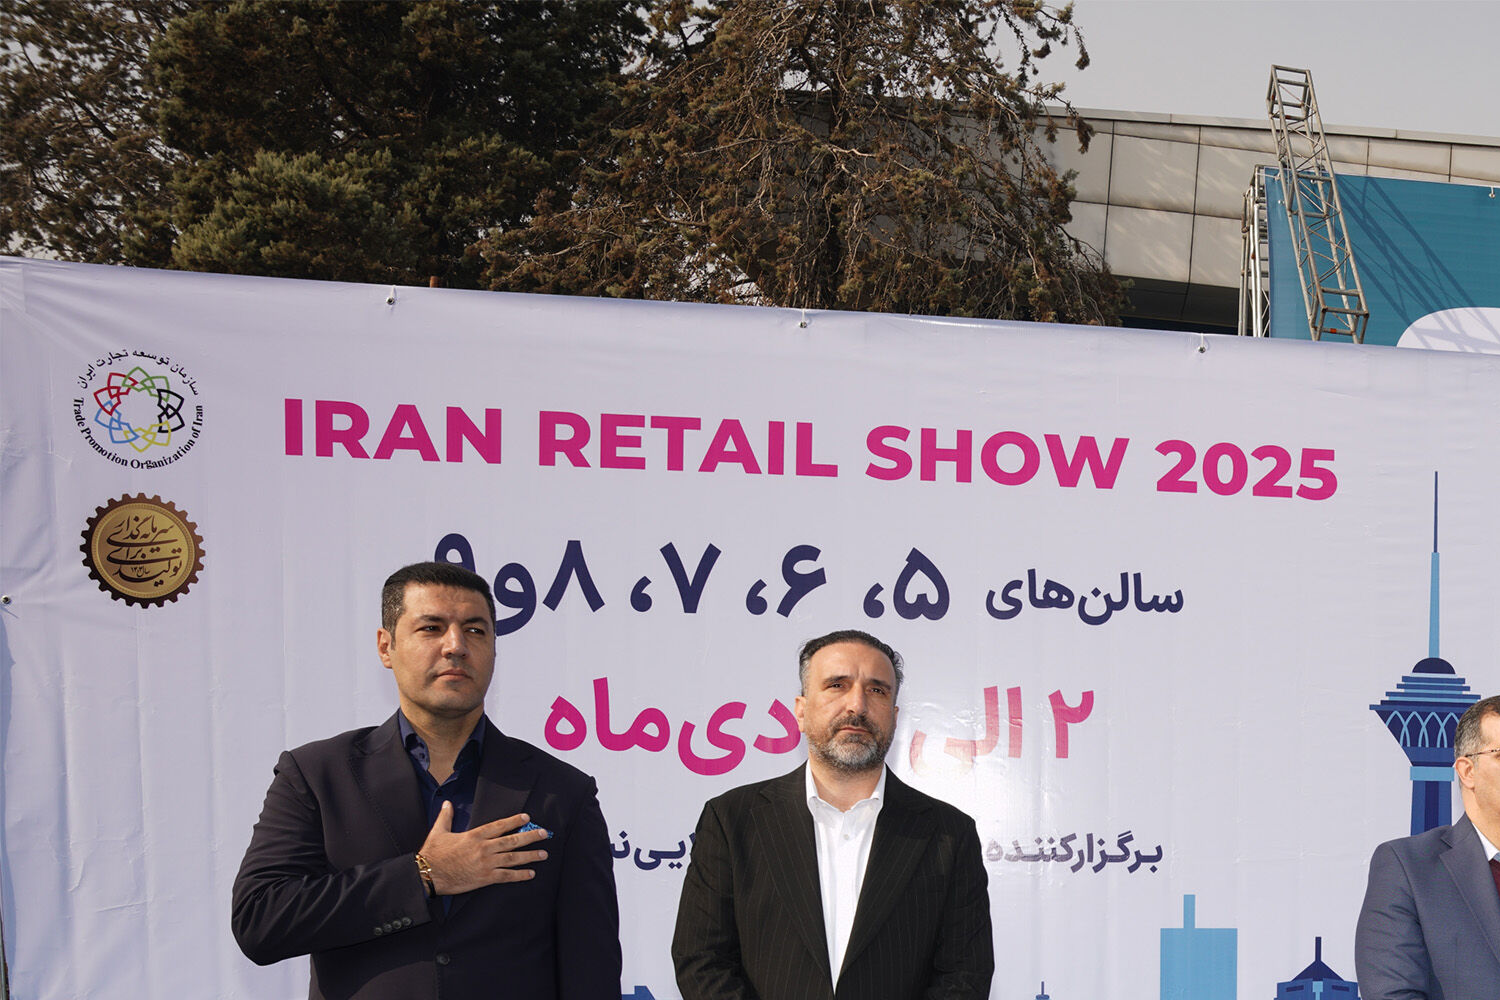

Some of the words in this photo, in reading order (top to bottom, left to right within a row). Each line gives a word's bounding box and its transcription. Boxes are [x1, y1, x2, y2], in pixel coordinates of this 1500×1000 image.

[73, 397, 86, 427] Trade
[192, 405, 203, 426] Iran
[80, 427, 128, 467] Promotion
[191, 426, 203, 439] of
[130, 439, 196, 470] Organization
[285, 399, 501, 464] IRAN
[540, 411, 838, 477] RETAIL
[866, 426, 1128, 489] SHOW
[1156, 440, 1337, 500] 2025
[1047, 688, 1095, 760] ۲
